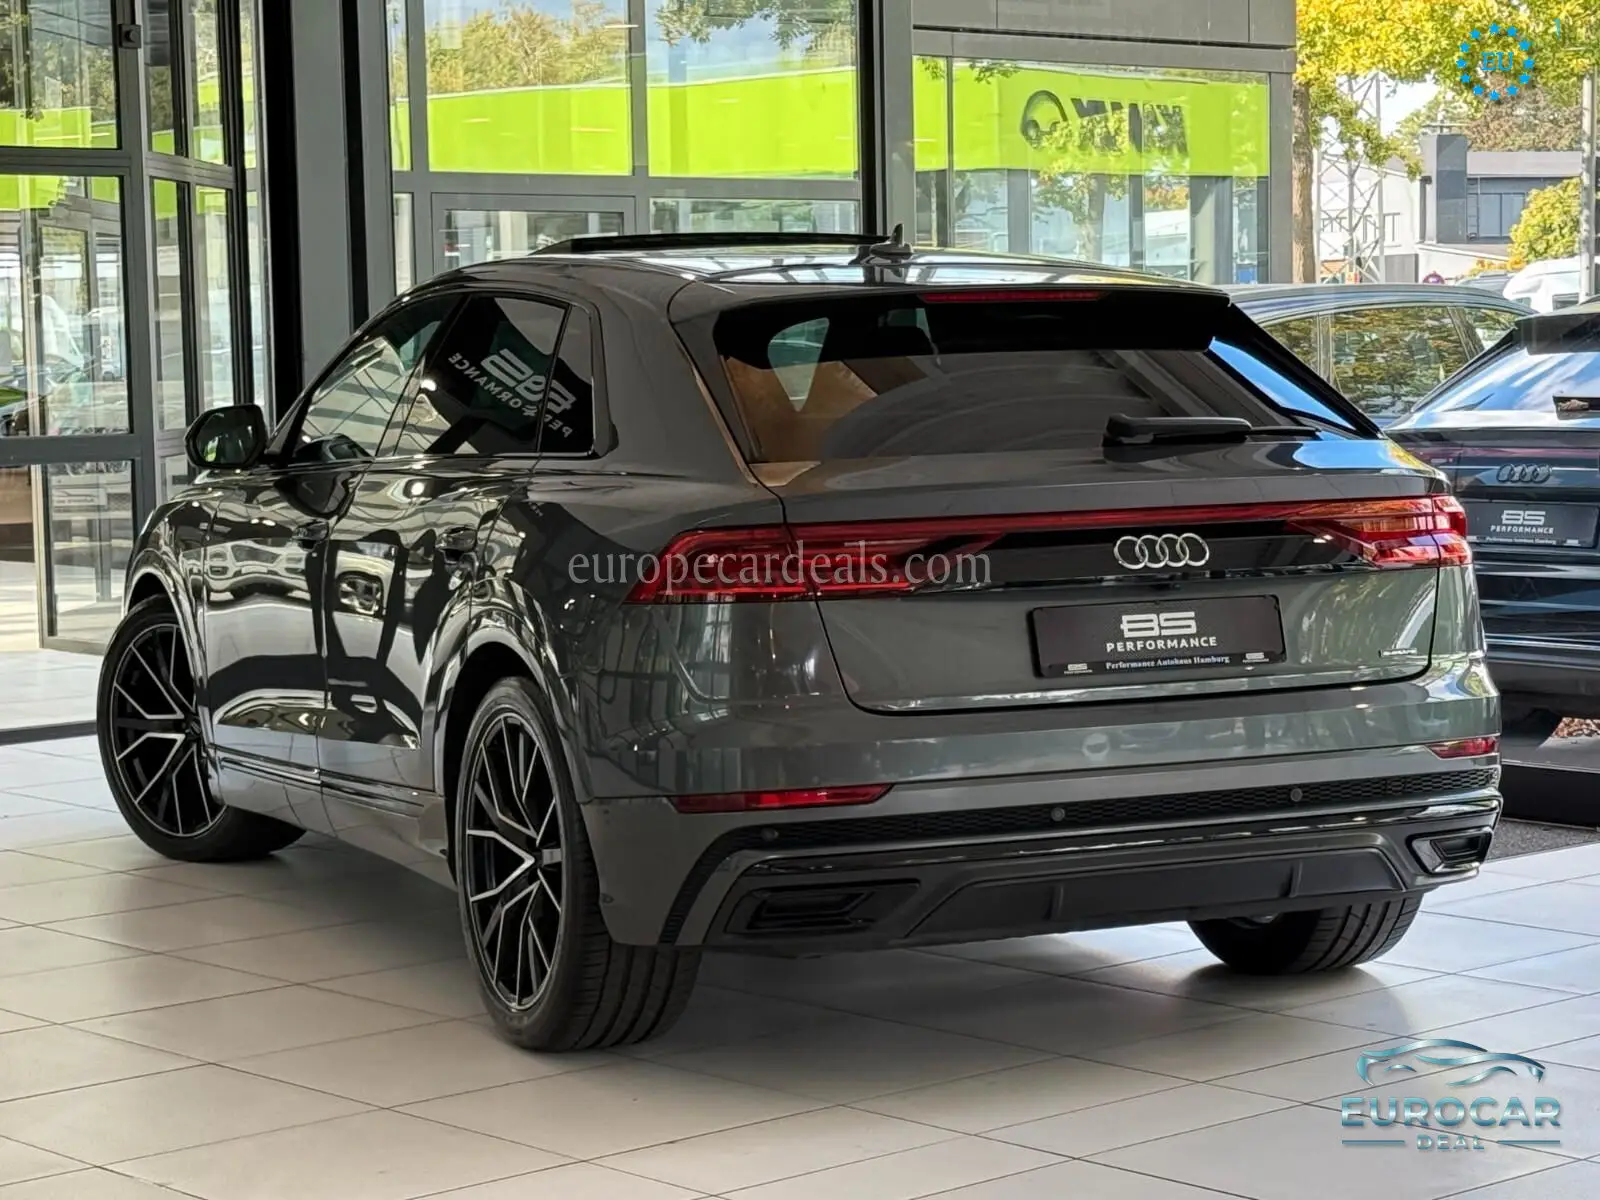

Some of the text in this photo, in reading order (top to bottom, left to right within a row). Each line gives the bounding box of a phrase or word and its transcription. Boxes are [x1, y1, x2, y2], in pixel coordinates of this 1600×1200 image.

[1490, 525, 1554, 535] PERFORMANCE
[1106, 636, 1218, 653] PERFORMANCE
[1105, 655, 1230, 670] Performance Autohaus Hamburg
